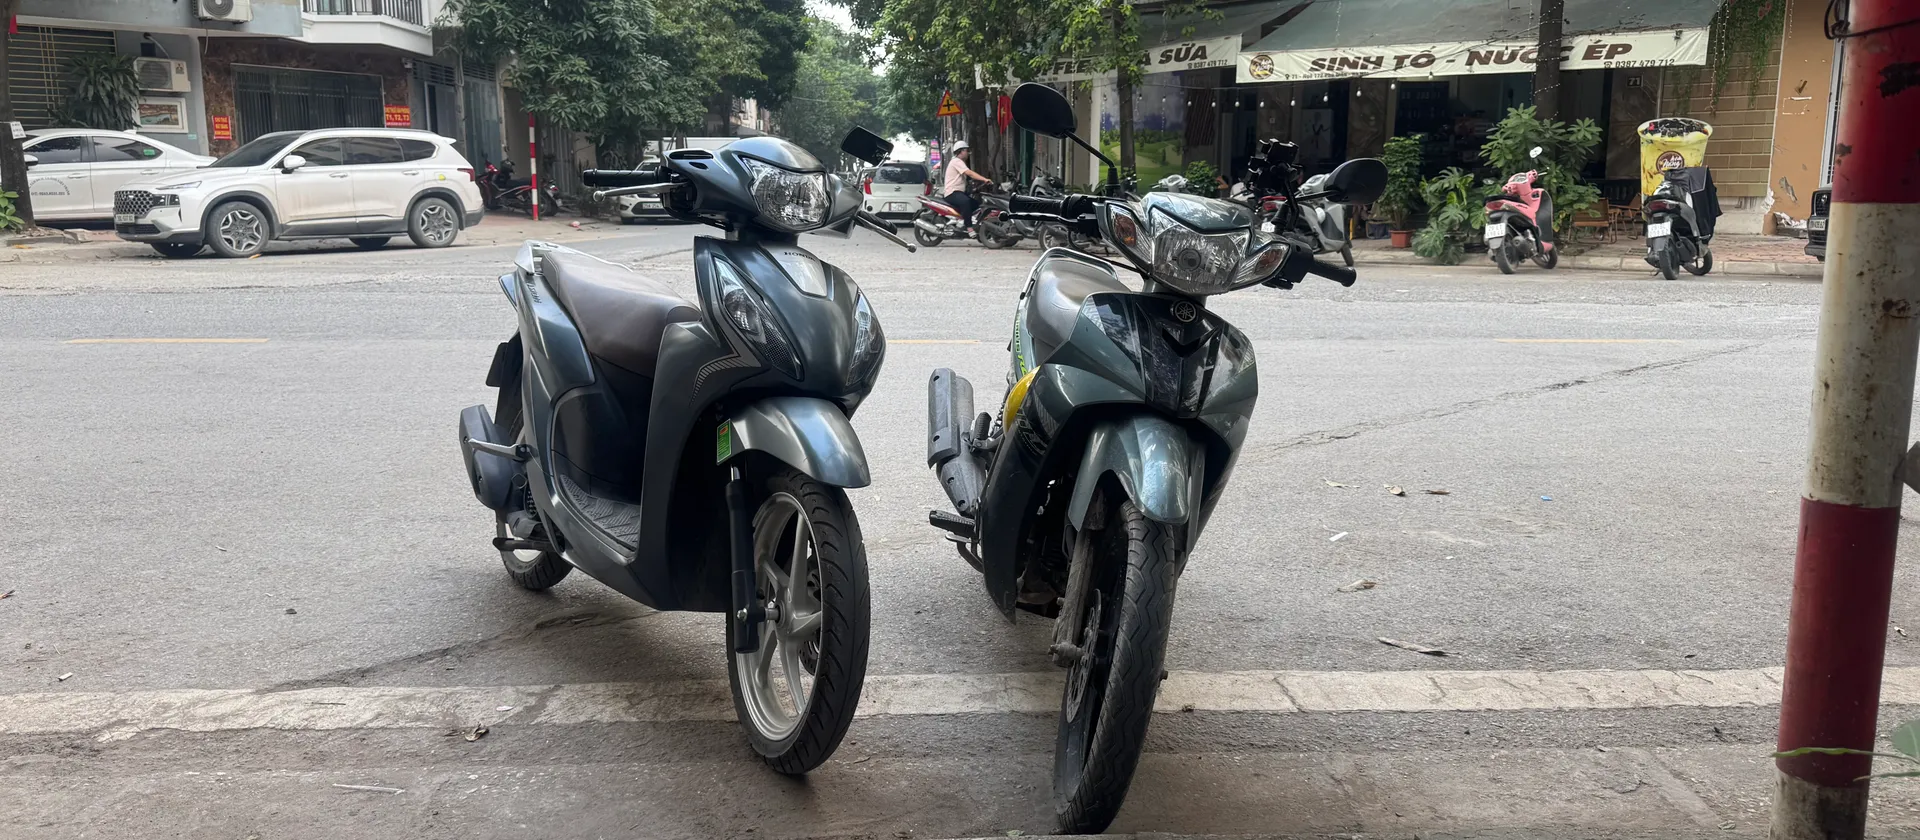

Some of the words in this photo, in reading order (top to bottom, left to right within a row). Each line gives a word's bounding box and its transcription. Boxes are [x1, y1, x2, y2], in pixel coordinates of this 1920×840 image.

[1158, 43, 1208, 64] SỮA
[1308, 56, 1385, 72] SINH
[1393, 45, 1437, 70] TỐ
[1581, 39, 1633, 60] ÉP
[1639, 60, 1656, 68] 479
[1628, 77, 1640, 86] 71
[784, 251, 816, 261] HONDA
